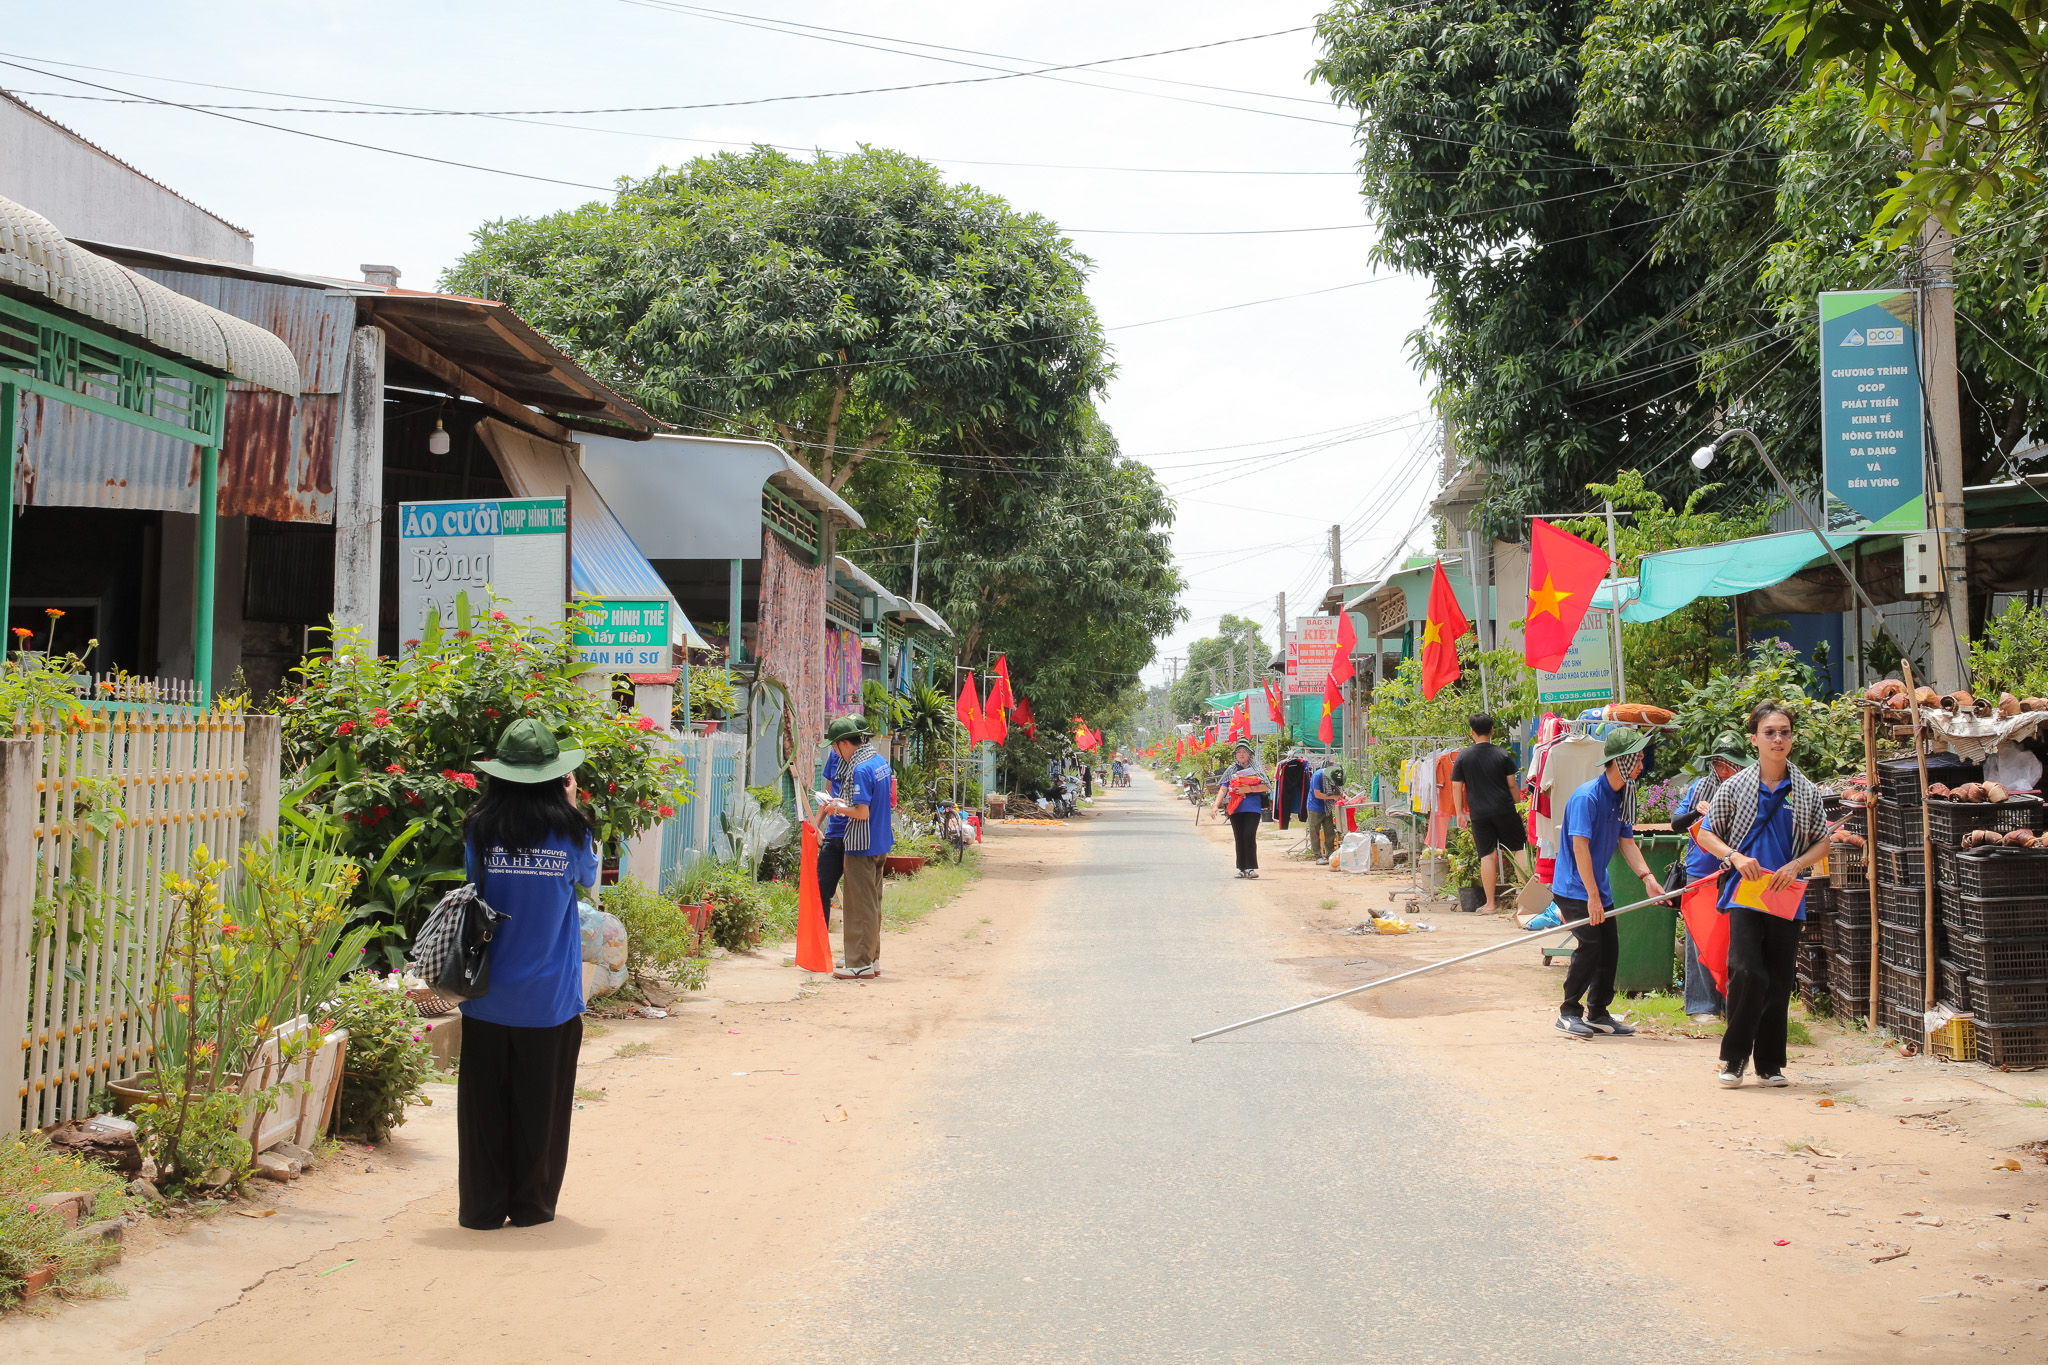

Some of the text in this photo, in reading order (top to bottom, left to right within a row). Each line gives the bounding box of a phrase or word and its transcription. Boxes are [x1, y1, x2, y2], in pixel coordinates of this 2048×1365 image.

[1868, 330, 1902, 341] OCOP
[1831, 365, 1908, 378] CHƯƠNG TRÌNH
[1857, 383, 1886, 393] OCOP
[1851, 412, 1892, 425] KINH TẾ
[1841, 429, 1904, 441] NÔNG THÔN
[1849, 446, 1897, 458] ĐA DẠNG
[1866, 461, 1881, 472] VÀ
[404, 503, 499, 536] ÁO CƯỚI
[503, 500, 566, 533] CHỤP HÌNH THẺ
[409, 540, 491, 590] Hồng
[578, 603, 665, 629] HỤP HÌNH THẺ
[588, 629, 652, 644] (lấy liền)
[1303, 626, 1337, 643] KIỆT
[614, 647, 634, 664] HỒ
[639, 651, 660, 664] SƠ
[512, 855, 531, 867] HÈ
[534, 857, 570, 870] XANH
